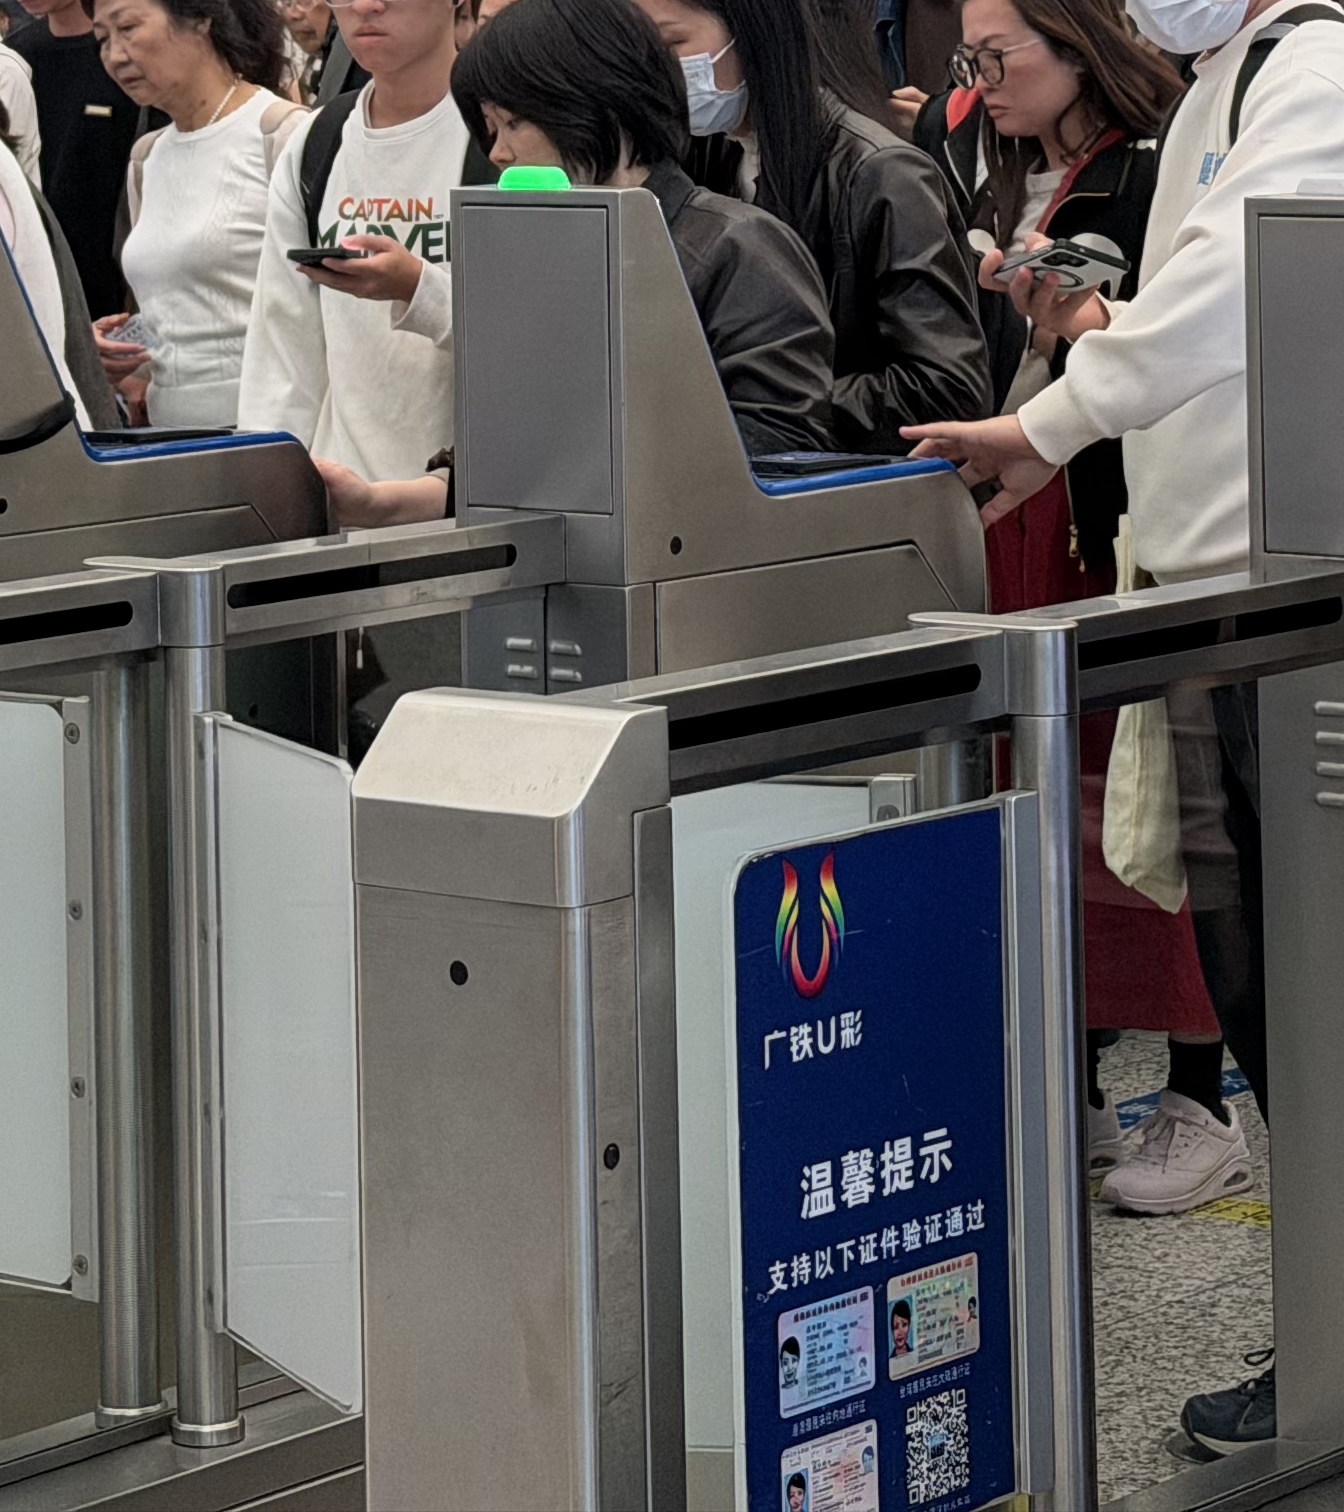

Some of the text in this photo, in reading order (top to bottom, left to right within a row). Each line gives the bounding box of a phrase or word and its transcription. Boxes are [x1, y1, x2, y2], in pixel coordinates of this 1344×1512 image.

[338, 197, 433, 222] CAPTAIN
[764, 1010, 862, 1070] 广铁U彩
[800, 1127, 953, 1219] 温馨提示
[768, 1199, 985, 1295] 支持以下证件验证通过
